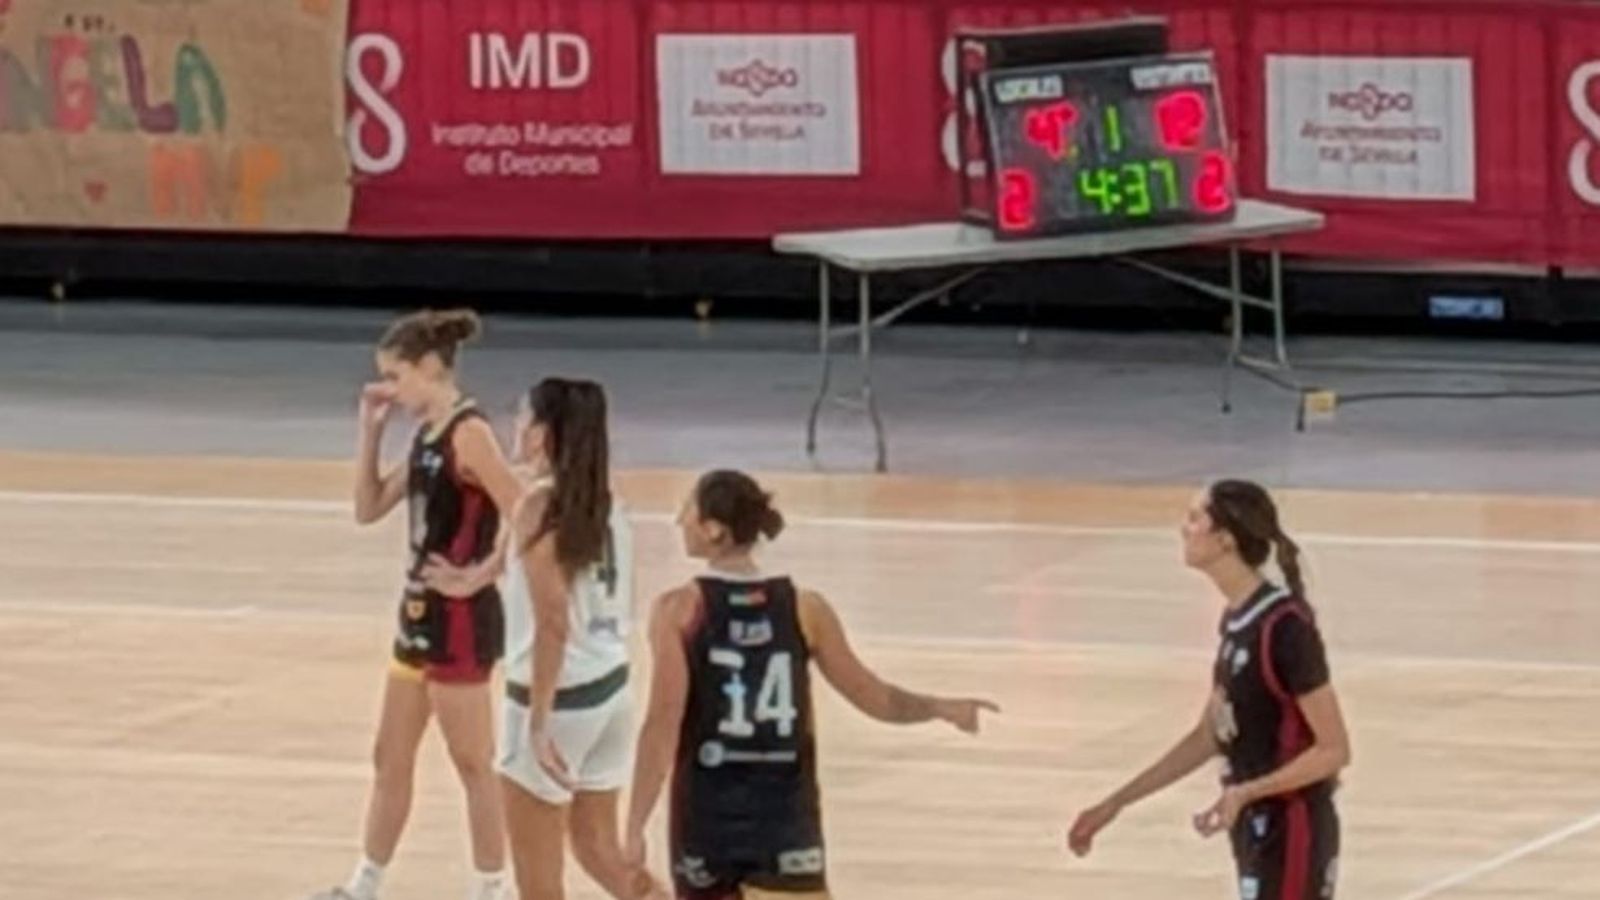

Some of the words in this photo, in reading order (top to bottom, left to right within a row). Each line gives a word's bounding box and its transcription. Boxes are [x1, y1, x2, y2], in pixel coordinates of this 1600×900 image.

[469, 32, 591, 89] IMD
[431, 122, 520, 146] Instituto
[524, 121, 634, 148] Municipal
[1105, 105, 1121, 152] 1
[464, 153, 494, 175] de
[499, 151, 600, 177] Deportes
[1079, 160, 1179, 215] 4:37
[1195, 152, 1230, 212] 2
[999, 168, 1035, 230] 2
[707, 646, 798, 737] 14
